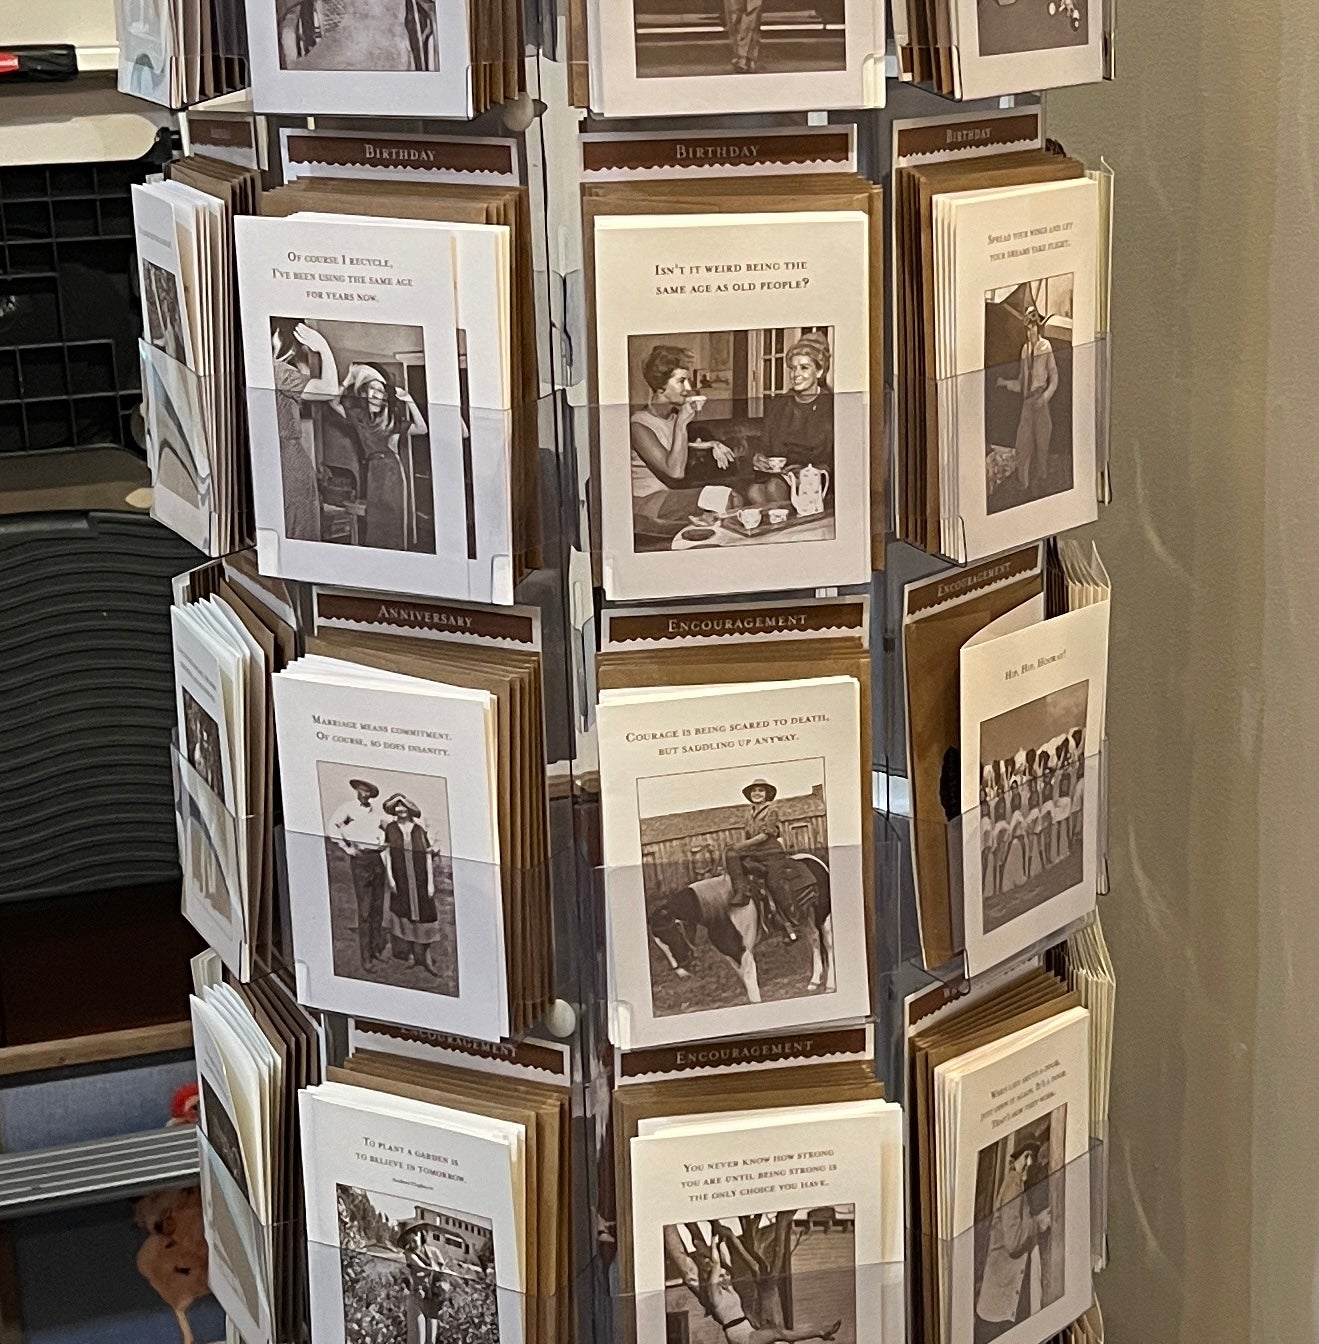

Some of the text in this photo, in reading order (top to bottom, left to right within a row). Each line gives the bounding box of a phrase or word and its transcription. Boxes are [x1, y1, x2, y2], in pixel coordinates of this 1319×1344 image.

[946, 127, 992, 144] BIRTHDAY
[364, 144, 436, 161] BIRTHDAY
[676, 144, 760, 159] BIRTHDAY
[655, 260, 808, 276] ISN'T IT WEIRD BEING THE
[655, 277, 810, 296] SAME AGE AS OLD PEOPLE?
[937, 562, 1012, 597] ENCOURAGEMENT
[378, 604, 473, 628] ANNIVERSARY
[668, 613, 808, 633] ENCOURAGEMENT
[626, 728, 678, 744] COURAGE
[694, 724, 726, 736] BEING
[729, 720, 770, 732] SCARED
[773, 718, 788, 727] TO
[658, 733, 800, 756] BUT SADDLING UP ANYWAY.
[675, 1040, 814, 1065] ENCOURAGEMENT
[683, 1162, 704, 1173] YOU
[707, 1159, 739, 1171] NEVER
[742, 1156, 770, 1167] KNOW
[680, 1178, 700, 1188] YOU
[703, 1176, 722, 1186] ARE
[789, 1166, 826, 1177] STRONG
[711, 1189, 736, 1200] ONLY
[779, 1182, 798, 1191] YOU
